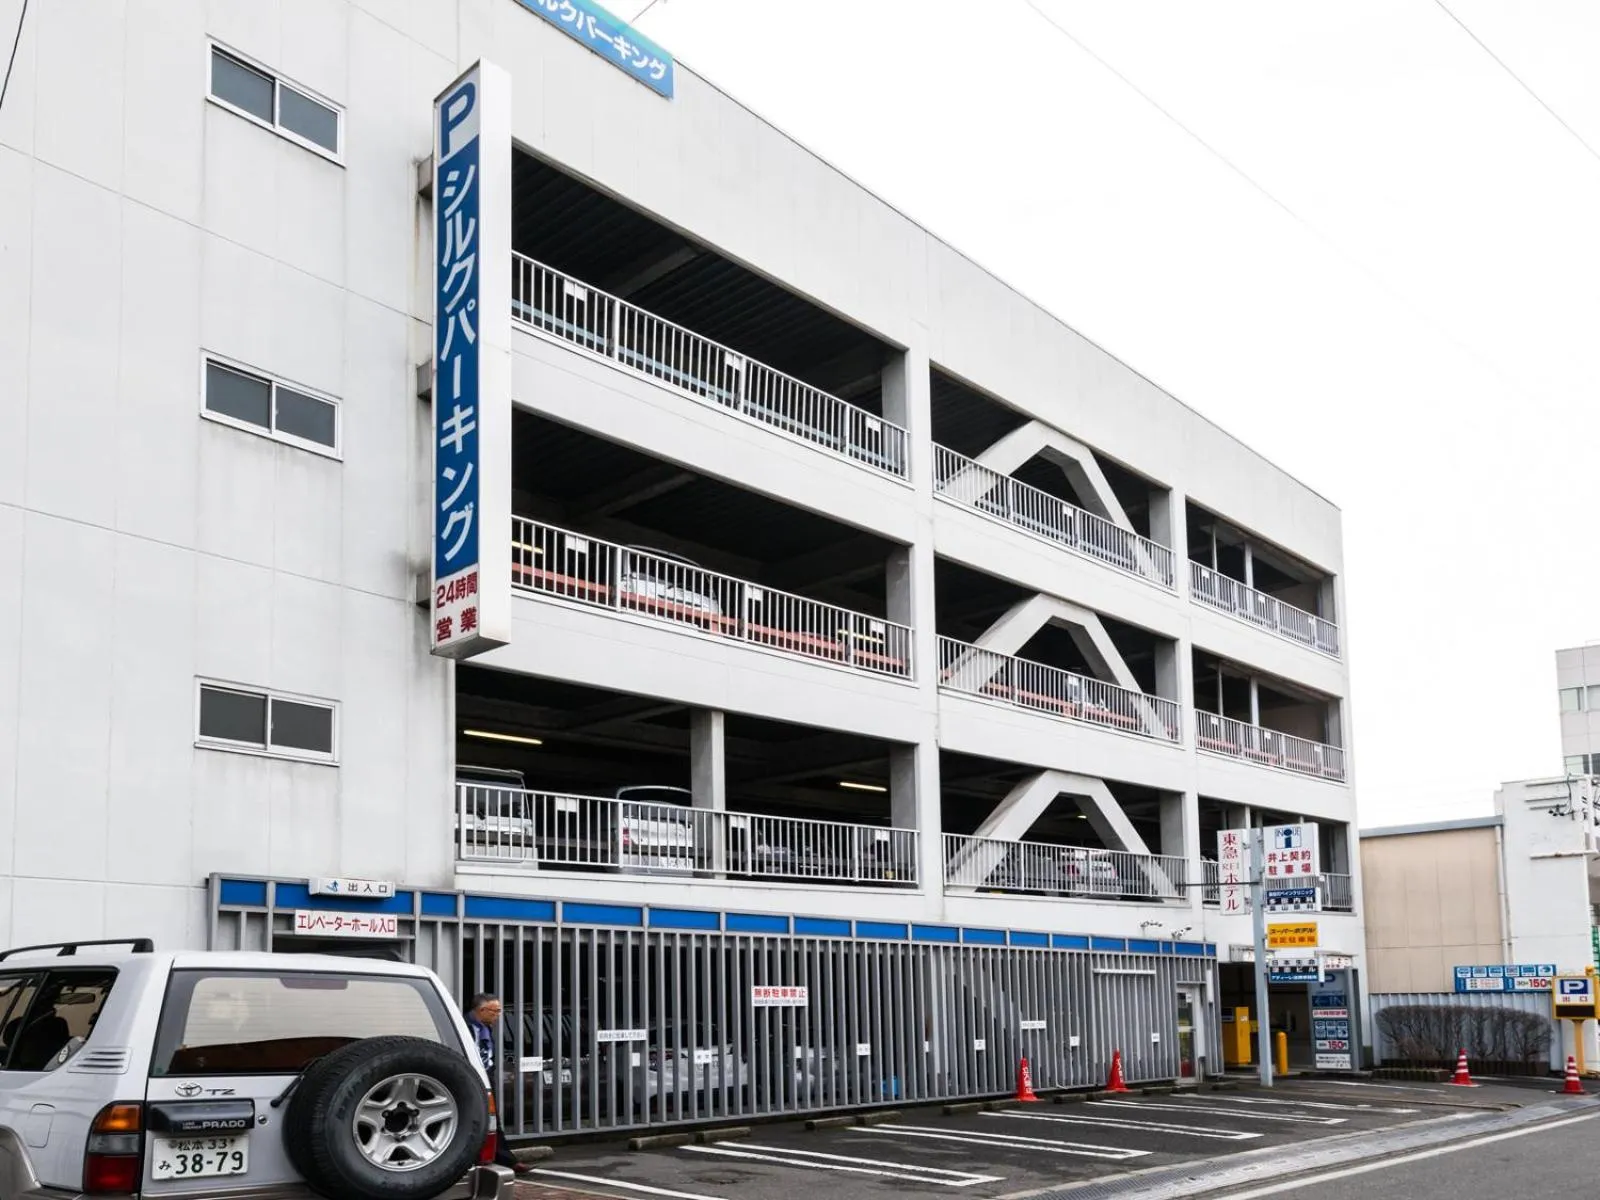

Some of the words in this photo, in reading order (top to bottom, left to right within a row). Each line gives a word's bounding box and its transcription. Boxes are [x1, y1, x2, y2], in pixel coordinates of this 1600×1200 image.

[440, 82, 476, 161] P
[438, 163, 477, 563] シルクパーキング
[436, 571, 479, 610] 24時間
[436, 607, 478, 643] 営業
[1267, 850, 1311, 863] 井上契約
[1268, 863, 1312, 876] 駐車場
[347, 882, 388, 894] 出入口
[297, 913, 396, 934] エレベーターホール入口
[754, 987, 807, 999] 無断駐車禁止
[1563, 980, 1585, 993] P
[202, 1119, 246, 1129] PRADO
[158, 1160, 172, 1171] み
[175, 1150, 244, 1175] 38-79
